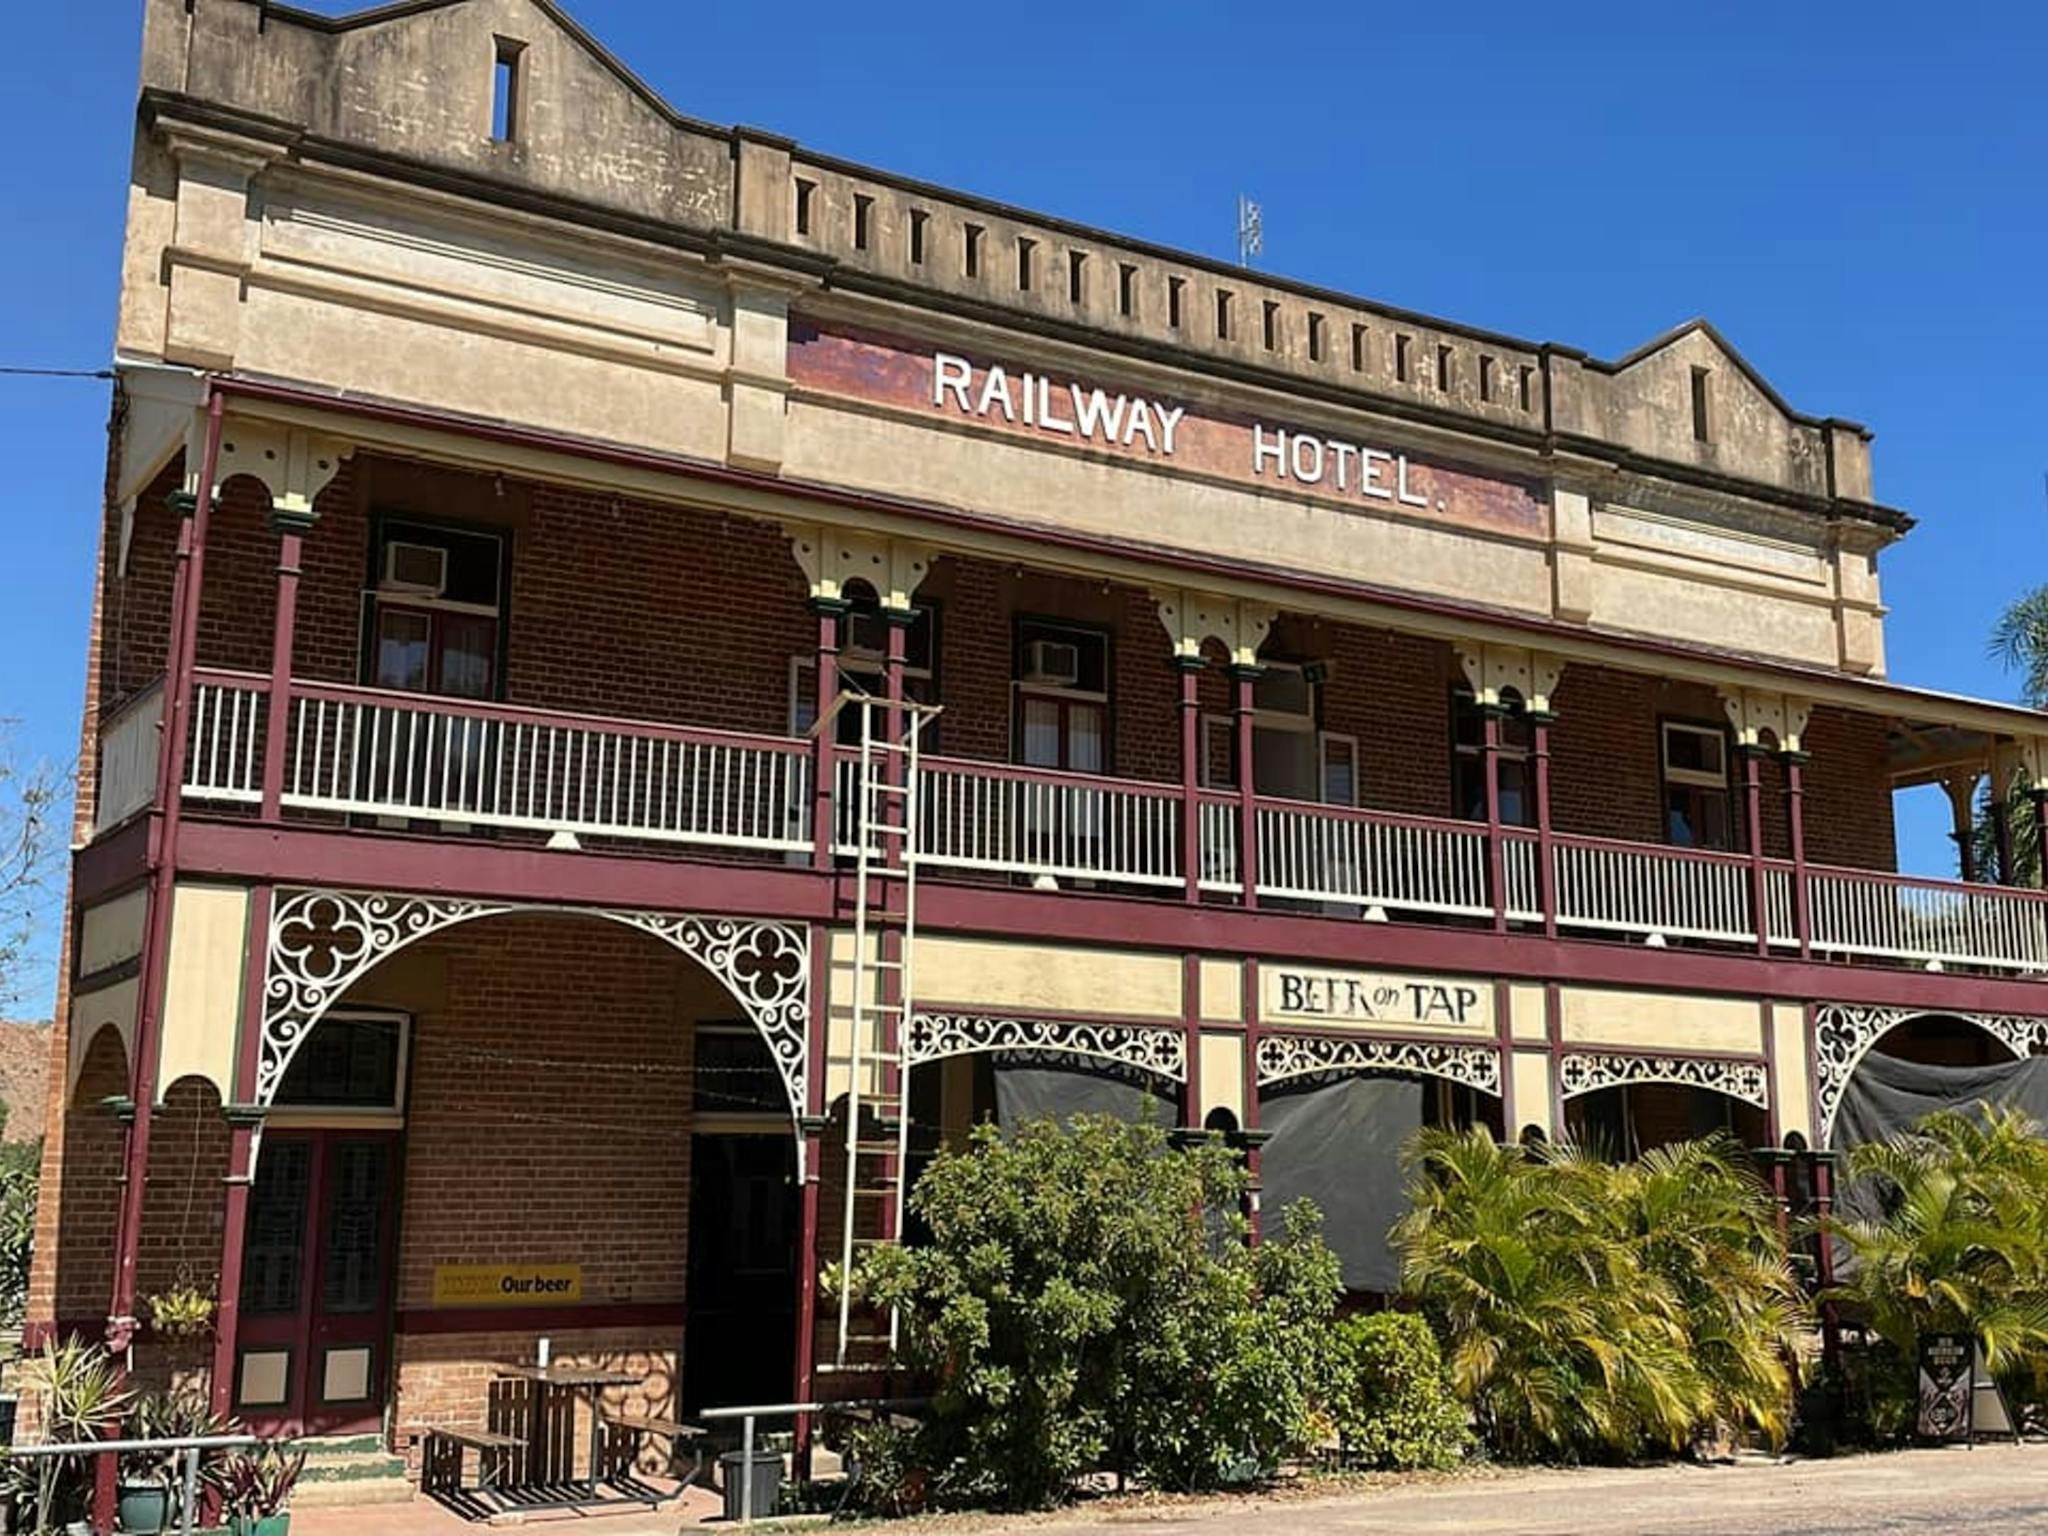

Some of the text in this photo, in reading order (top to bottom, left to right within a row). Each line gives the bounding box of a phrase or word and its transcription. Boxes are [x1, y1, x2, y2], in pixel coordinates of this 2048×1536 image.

[933, 352, 1186, 454] RAILWAY
[1374, 986, 1400, 1007] on
[1405, 984, 1477, 1023] TAP
[502, 1275, 532, 1294] Our
[534, 1274, 572, 1293] beer
